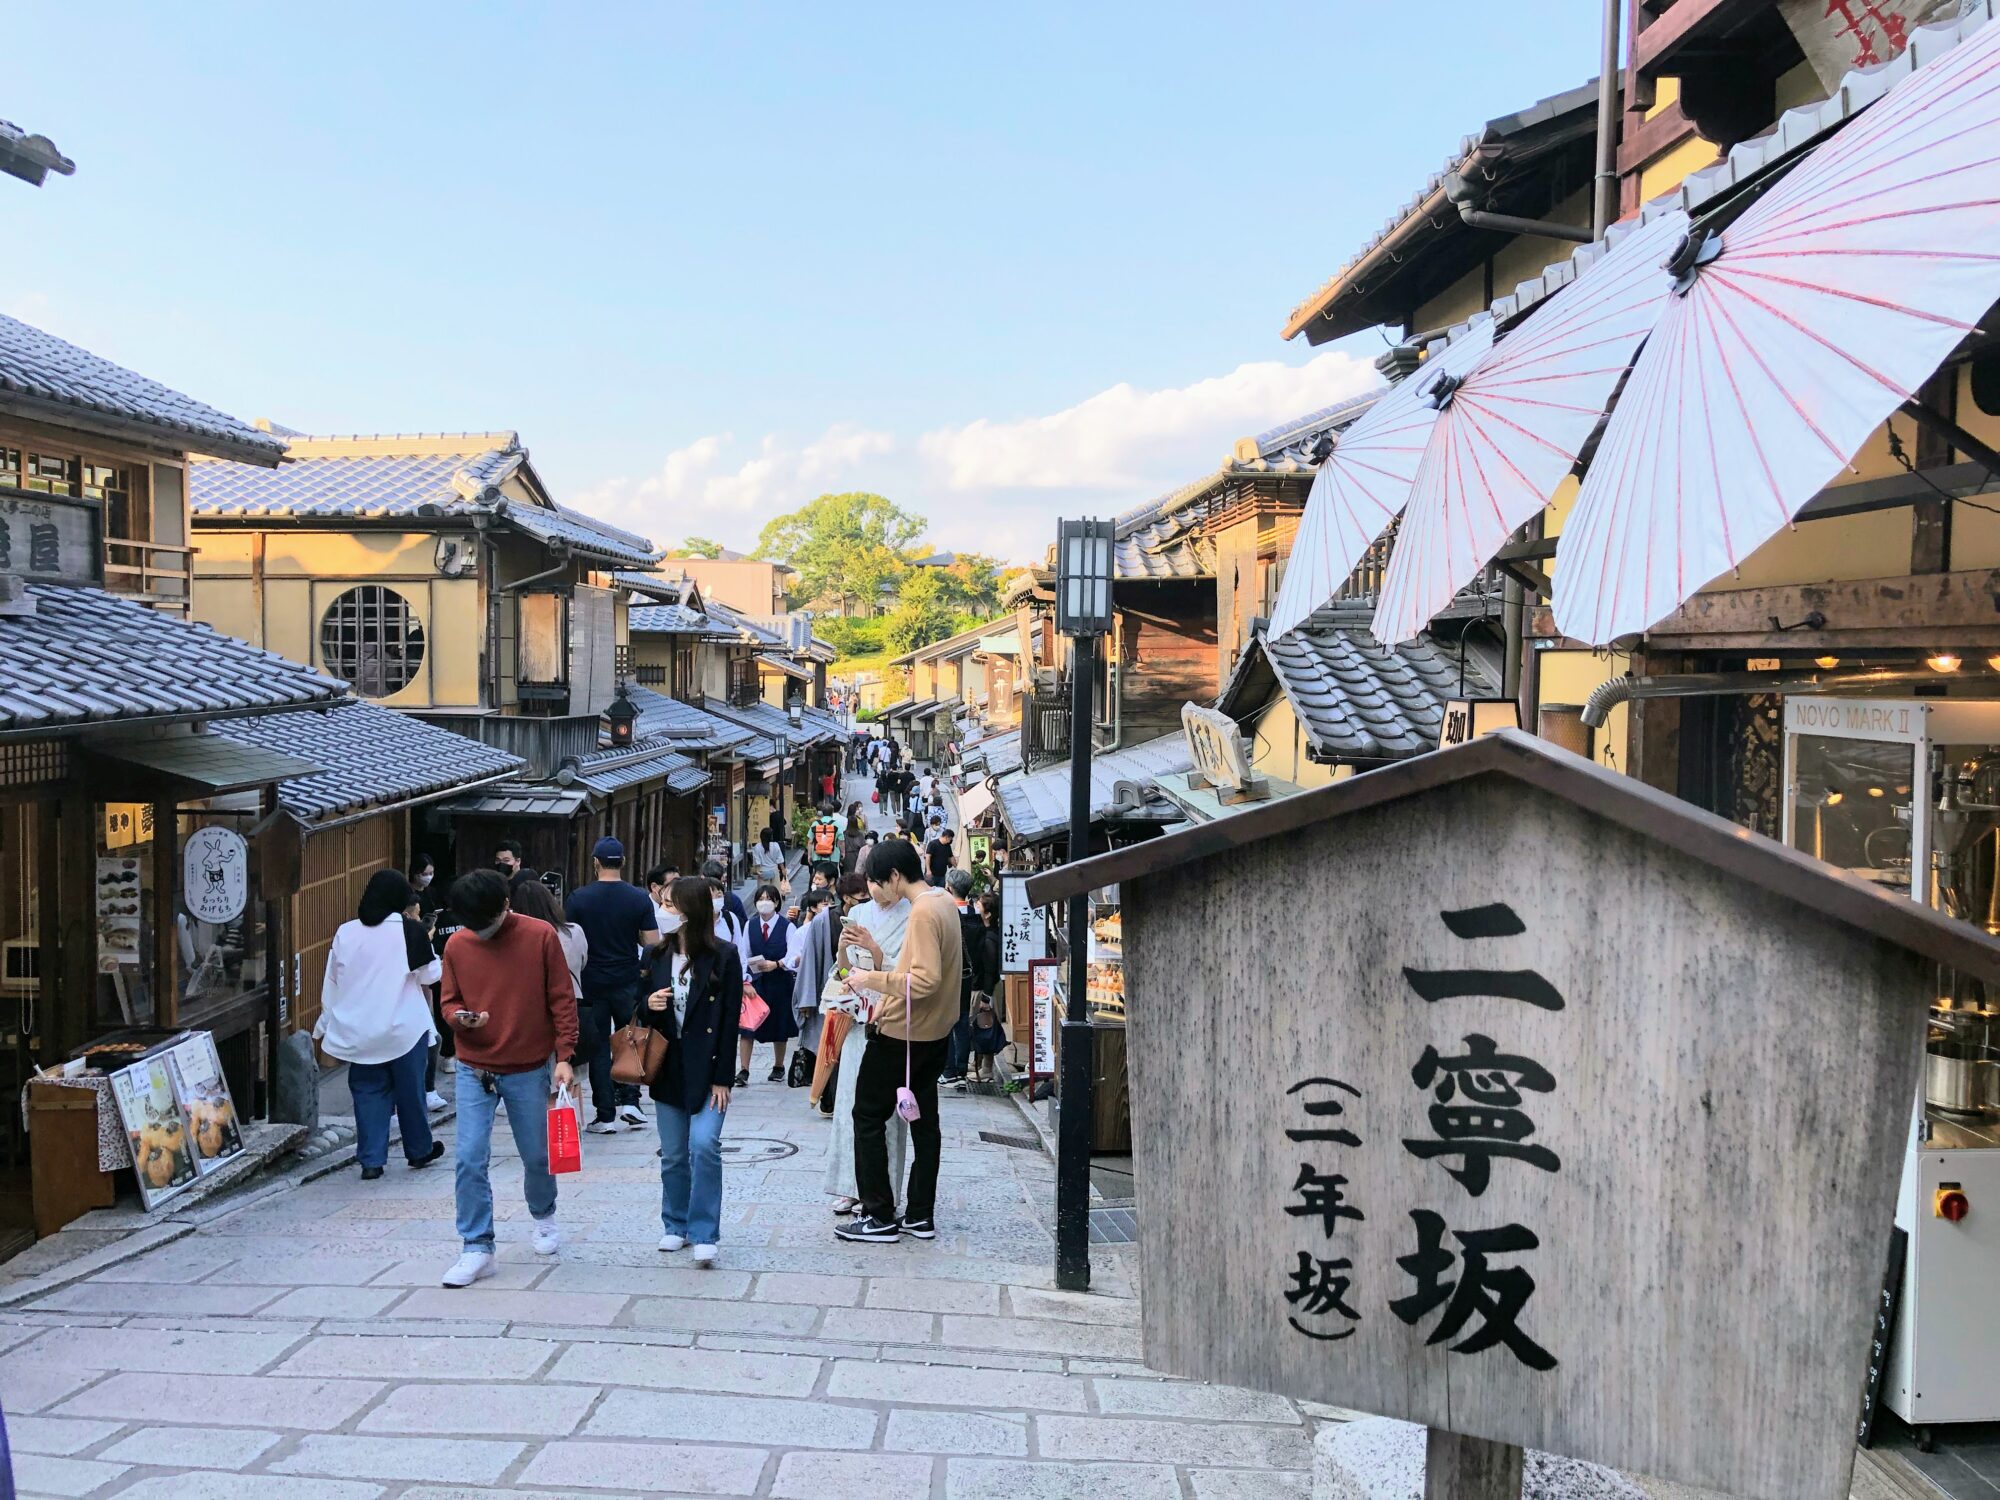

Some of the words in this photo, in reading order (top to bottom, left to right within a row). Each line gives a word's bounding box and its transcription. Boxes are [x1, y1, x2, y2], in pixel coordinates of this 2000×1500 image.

[1796, 703, 1840, 729] NOVO
[1846, 708, 1894, 733] MARK
[1003, 923, 1020, 963] ふたば
[1388, 902, 1566, 1371] 二寧坂
